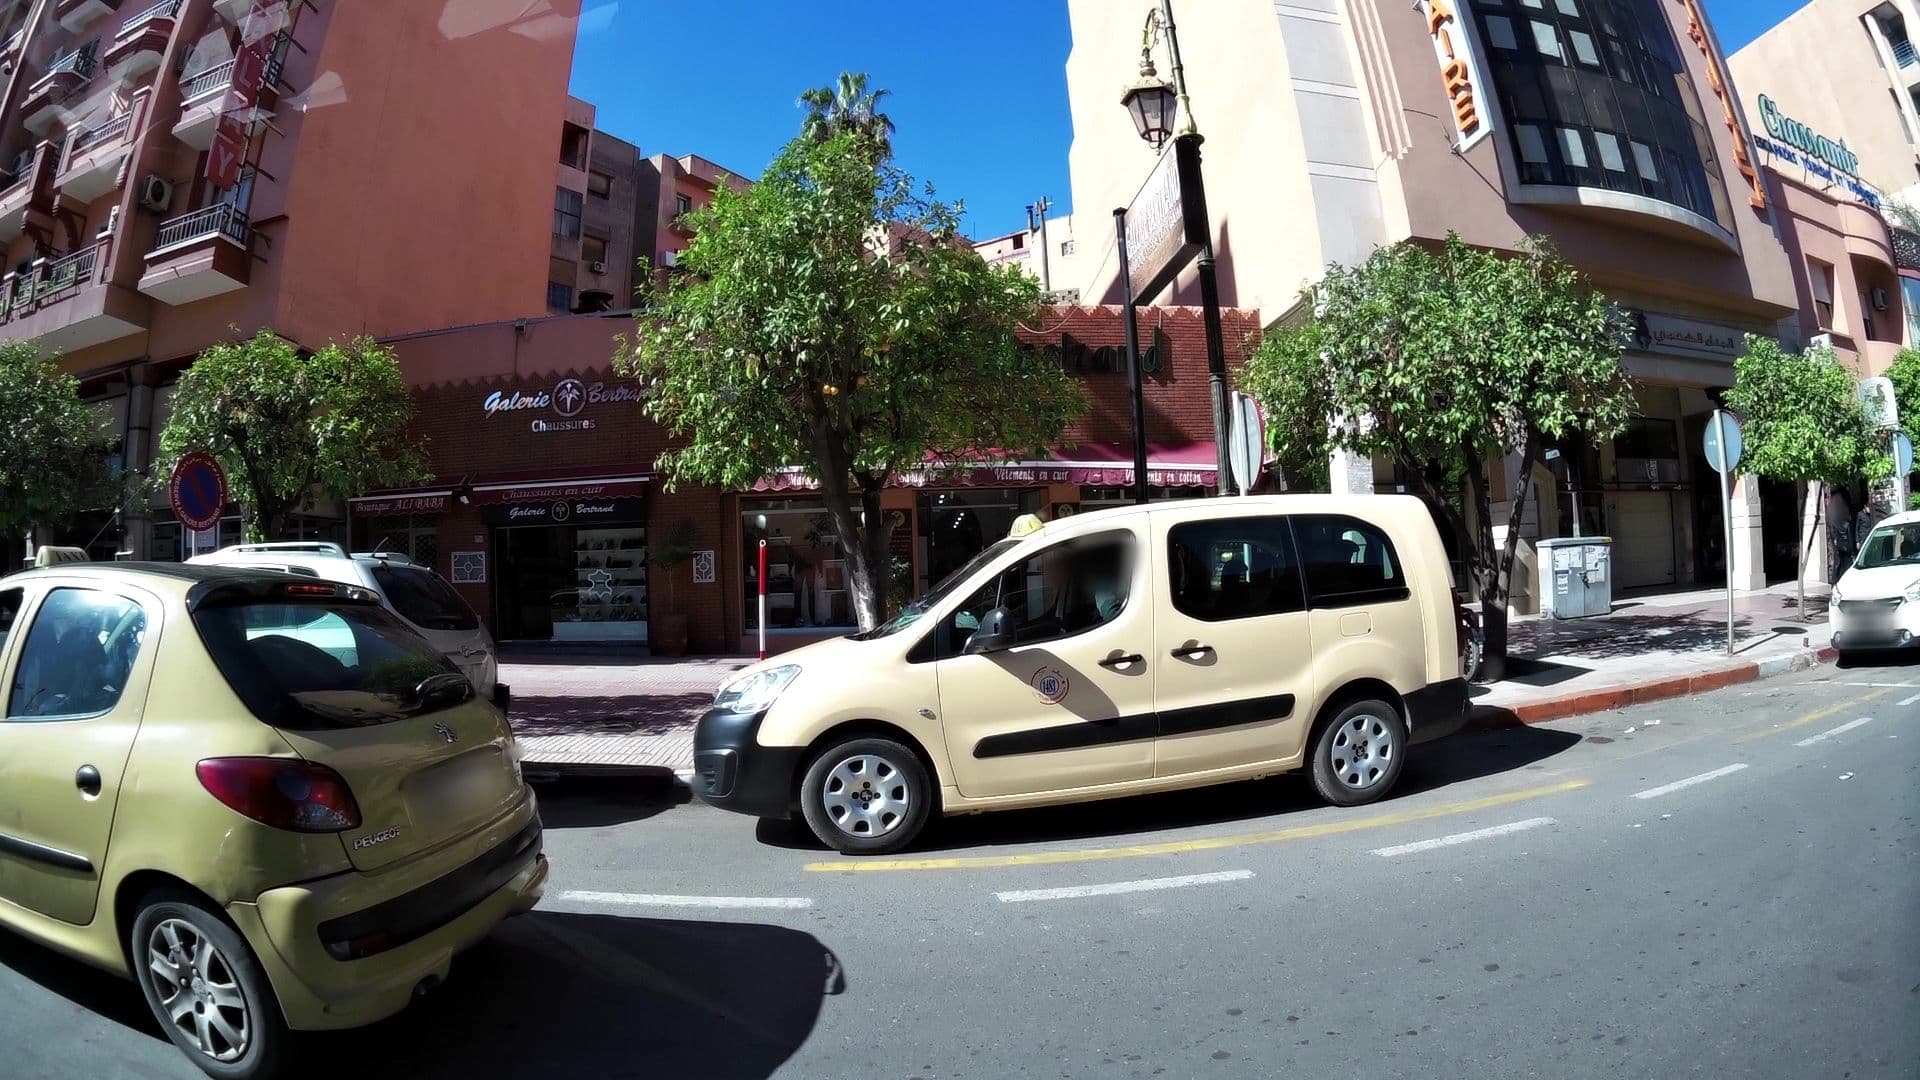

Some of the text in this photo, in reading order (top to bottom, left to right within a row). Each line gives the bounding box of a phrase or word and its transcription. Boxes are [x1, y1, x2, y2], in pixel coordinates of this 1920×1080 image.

[484, 390, 550, 419] Galerie
[531, 419, 596, 433] Chaussures
[502, 486, 606, 500] Chaussures en cuir
[509, 503, 615, 519] Galerie Bertrand
